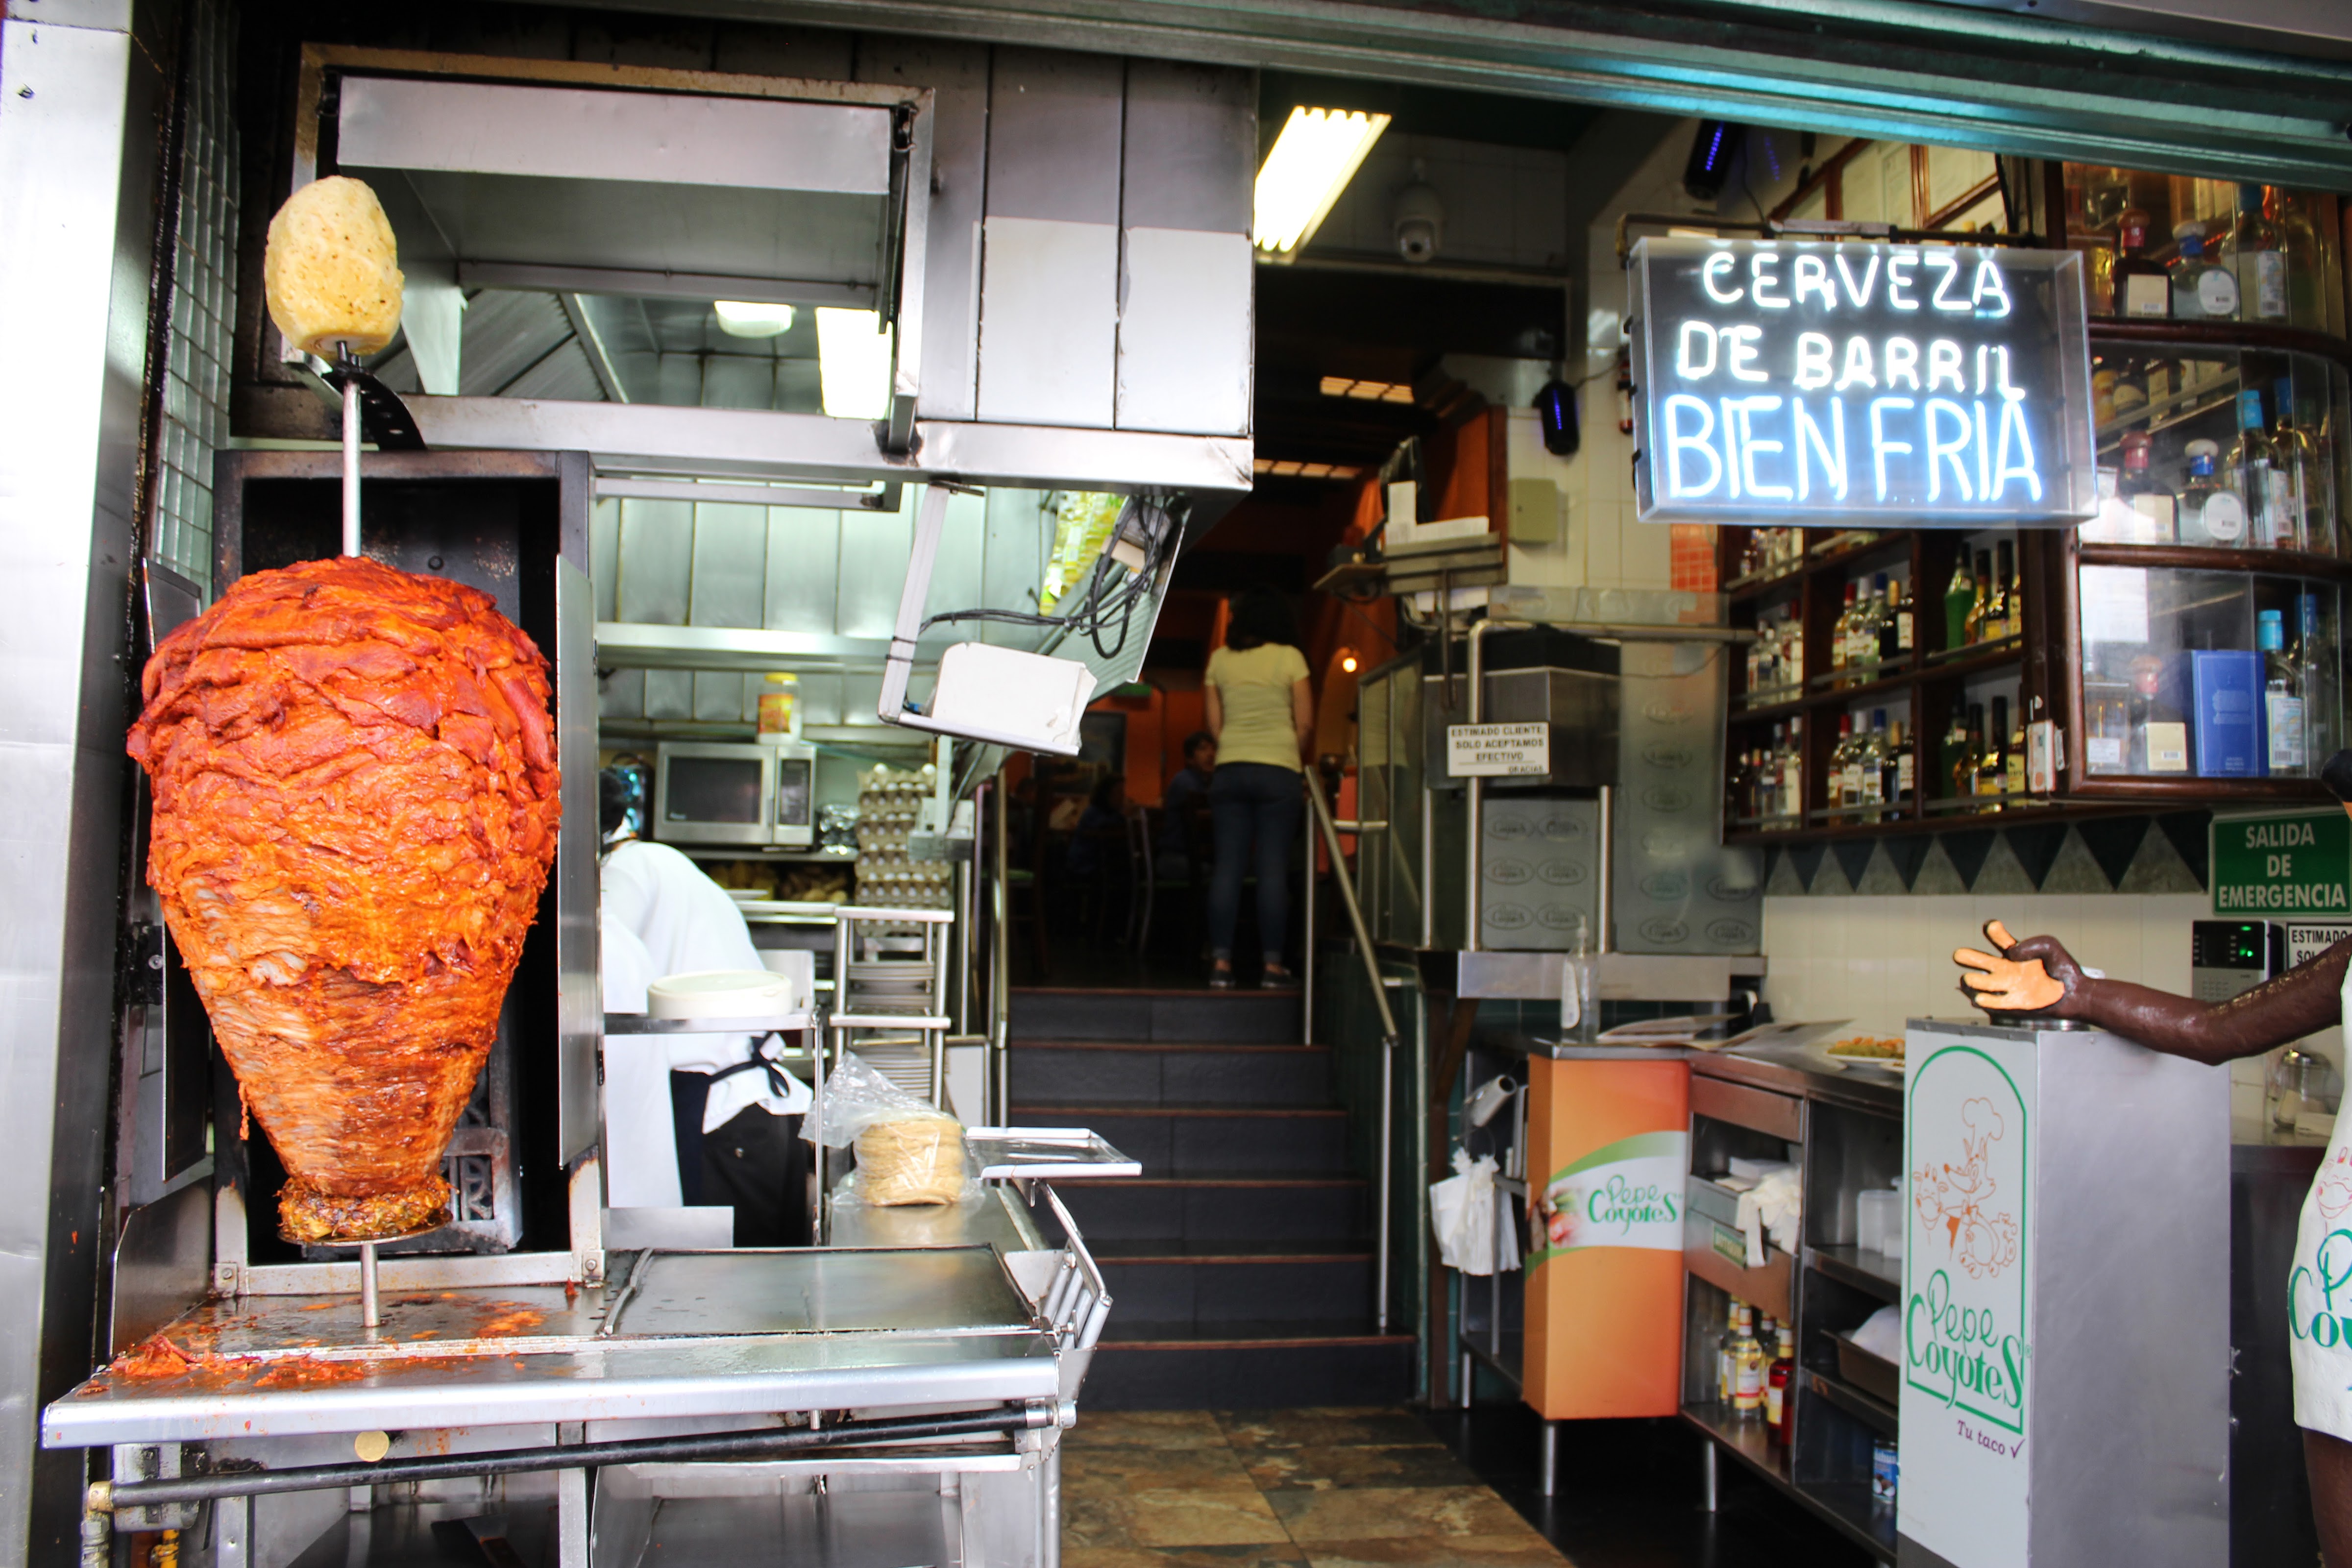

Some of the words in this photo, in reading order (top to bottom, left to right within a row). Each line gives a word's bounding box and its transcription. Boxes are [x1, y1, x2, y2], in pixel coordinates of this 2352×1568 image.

[1703, 250, 2012, 318] CERVEZA
[1676, 319, 1770, 382] DE
[1792, 331, 2027, 401] BARRIL
[1664, 393, 1848, 502] BIEN
[1869, 396, 2042, 503] FRIA
[1451, 726, 1499, 736] ESTIMADO
[1455, 740, 1481, 749] SOLO
[1485, 737, 1544, 748] ACEPTAMOS
[1476, 752, 1524, 761] EFECTIVO
[1508, 765, 1544, 773] GRACIAS
[2246, 822, 2315, 849] SALIDA
[2267, 854, 2292, 878] DE
[2218, 883, 2347, 908] EMERGENCIA
[2292, 930, 2348, 943] ESTIMADO
[1607, 1174, 1661, 1209] Pepe
[1928, 1269, 1999, 1354] Pepe
[1958, 1420, 1973, 1440] Tu
[1978, 1430, 2005, 1455] taco
